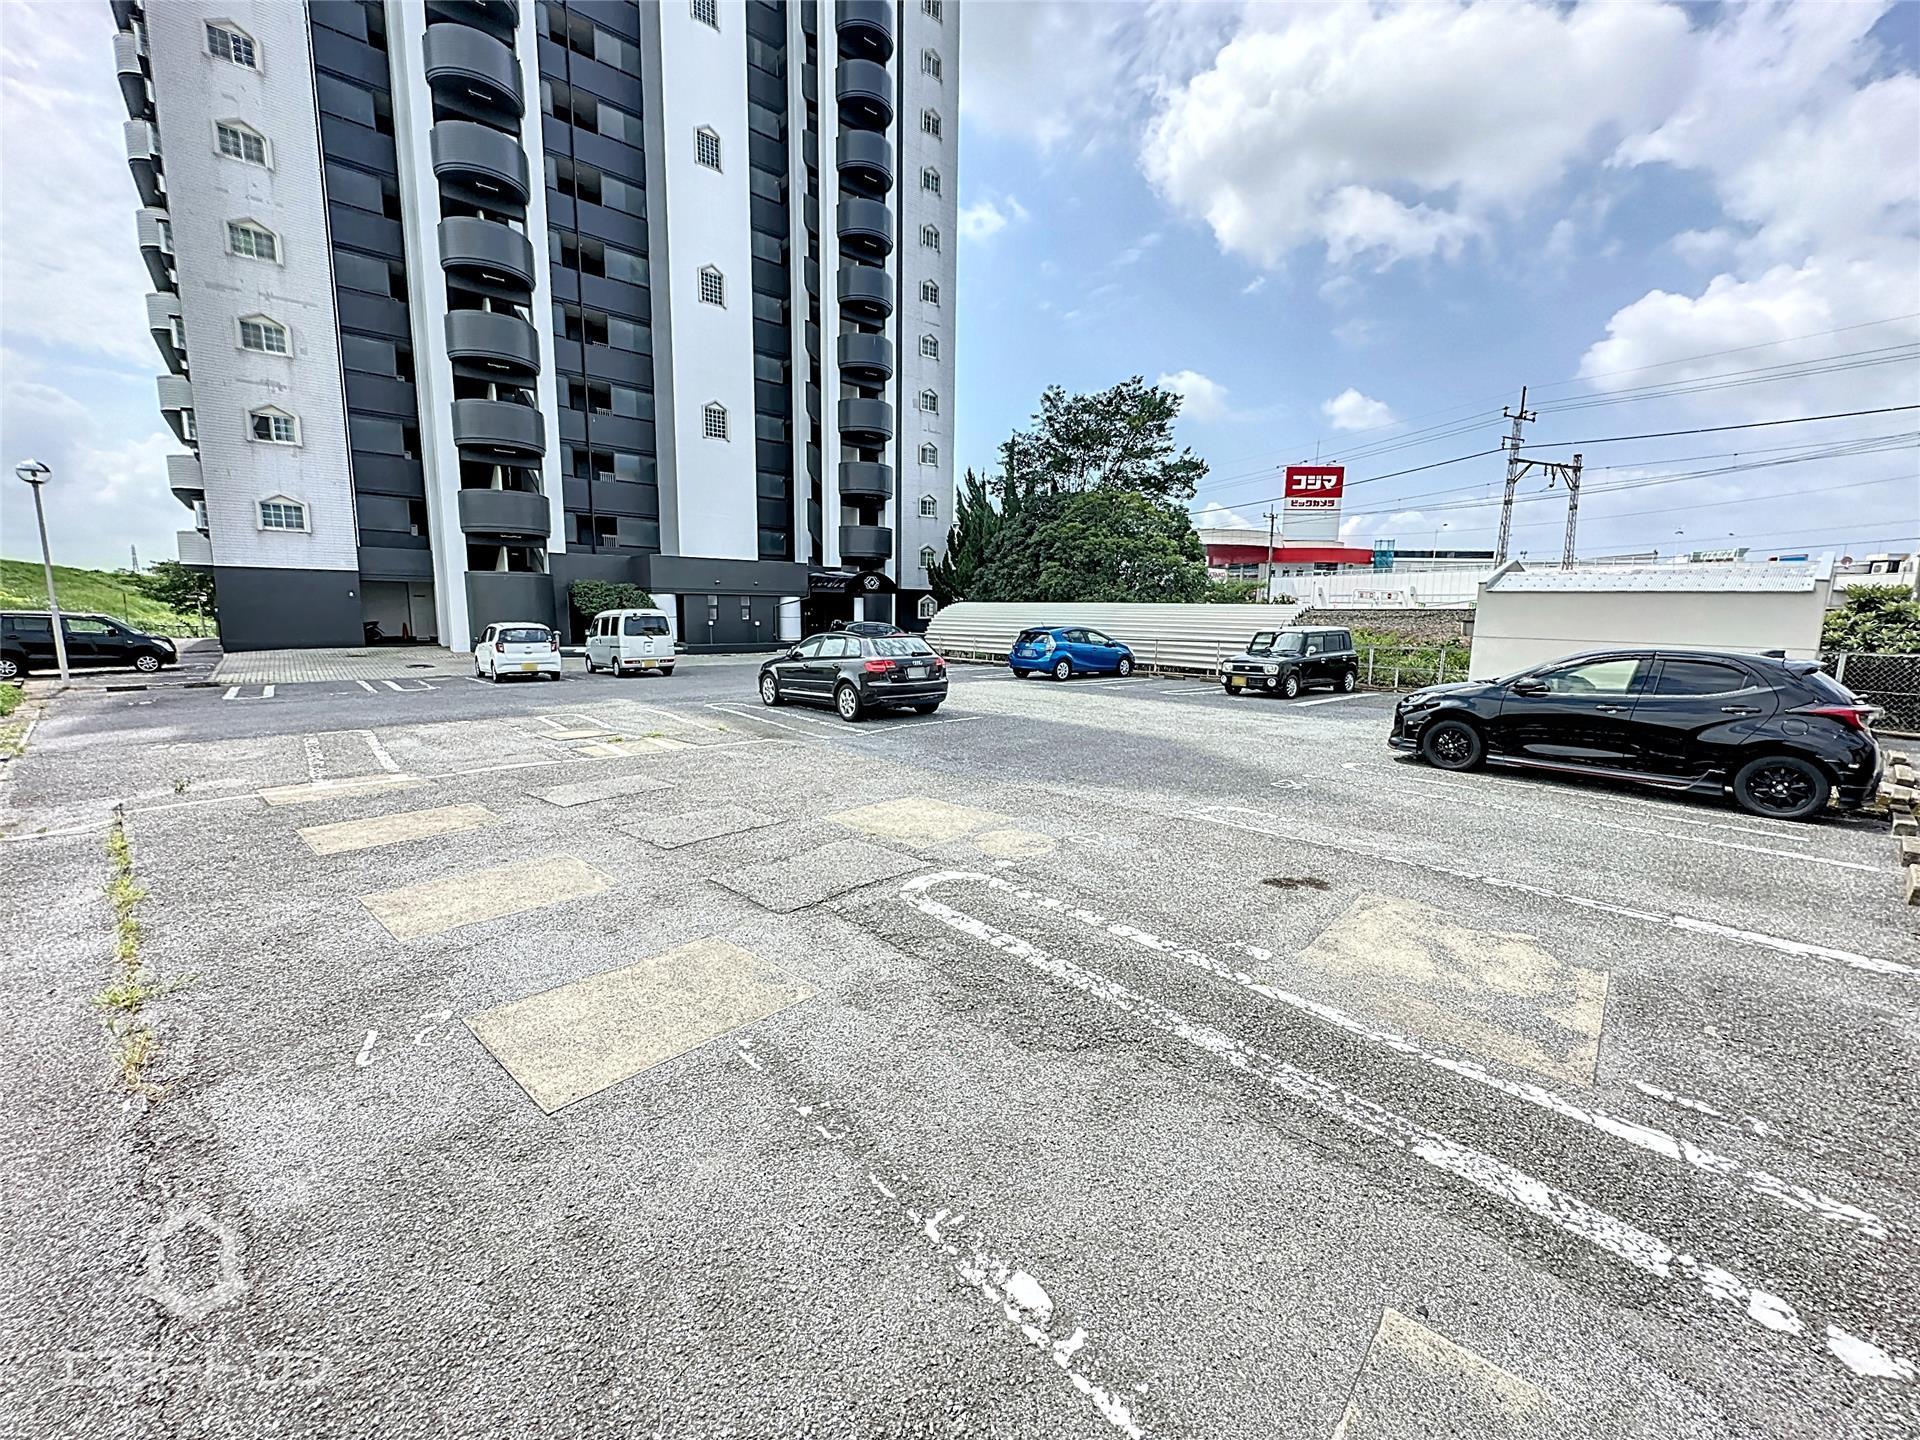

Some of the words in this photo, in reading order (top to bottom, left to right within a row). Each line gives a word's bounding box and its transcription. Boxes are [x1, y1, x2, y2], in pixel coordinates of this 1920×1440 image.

[1292, 475, 1337, 489] コジマ
[1291, 499, 1335, 507] ビックカメラ
